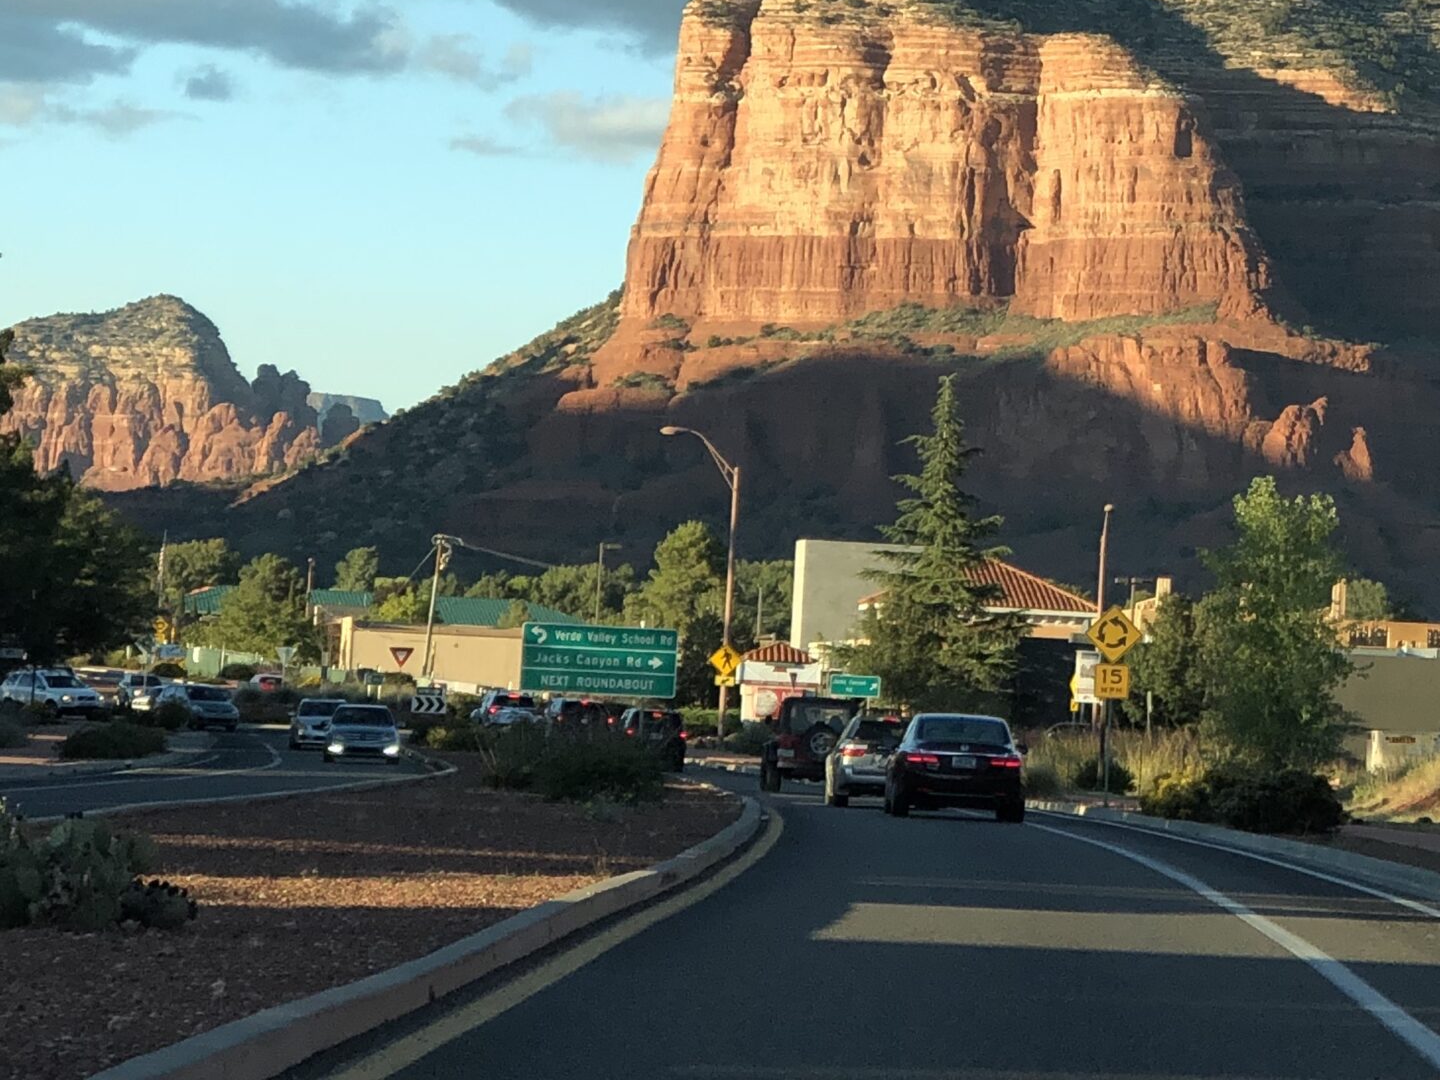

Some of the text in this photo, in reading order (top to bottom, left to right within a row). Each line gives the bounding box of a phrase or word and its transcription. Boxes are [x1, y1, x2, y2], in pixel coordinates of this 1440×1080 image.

[554, 630, 673, 646] Verde Valley School Rd
[534, 653, 642, 668] Jacks Canyon Rd
[540, 675, 654, 690] NEXT ROUNDABOUT
[1102, 669, 1122, 684] 15
